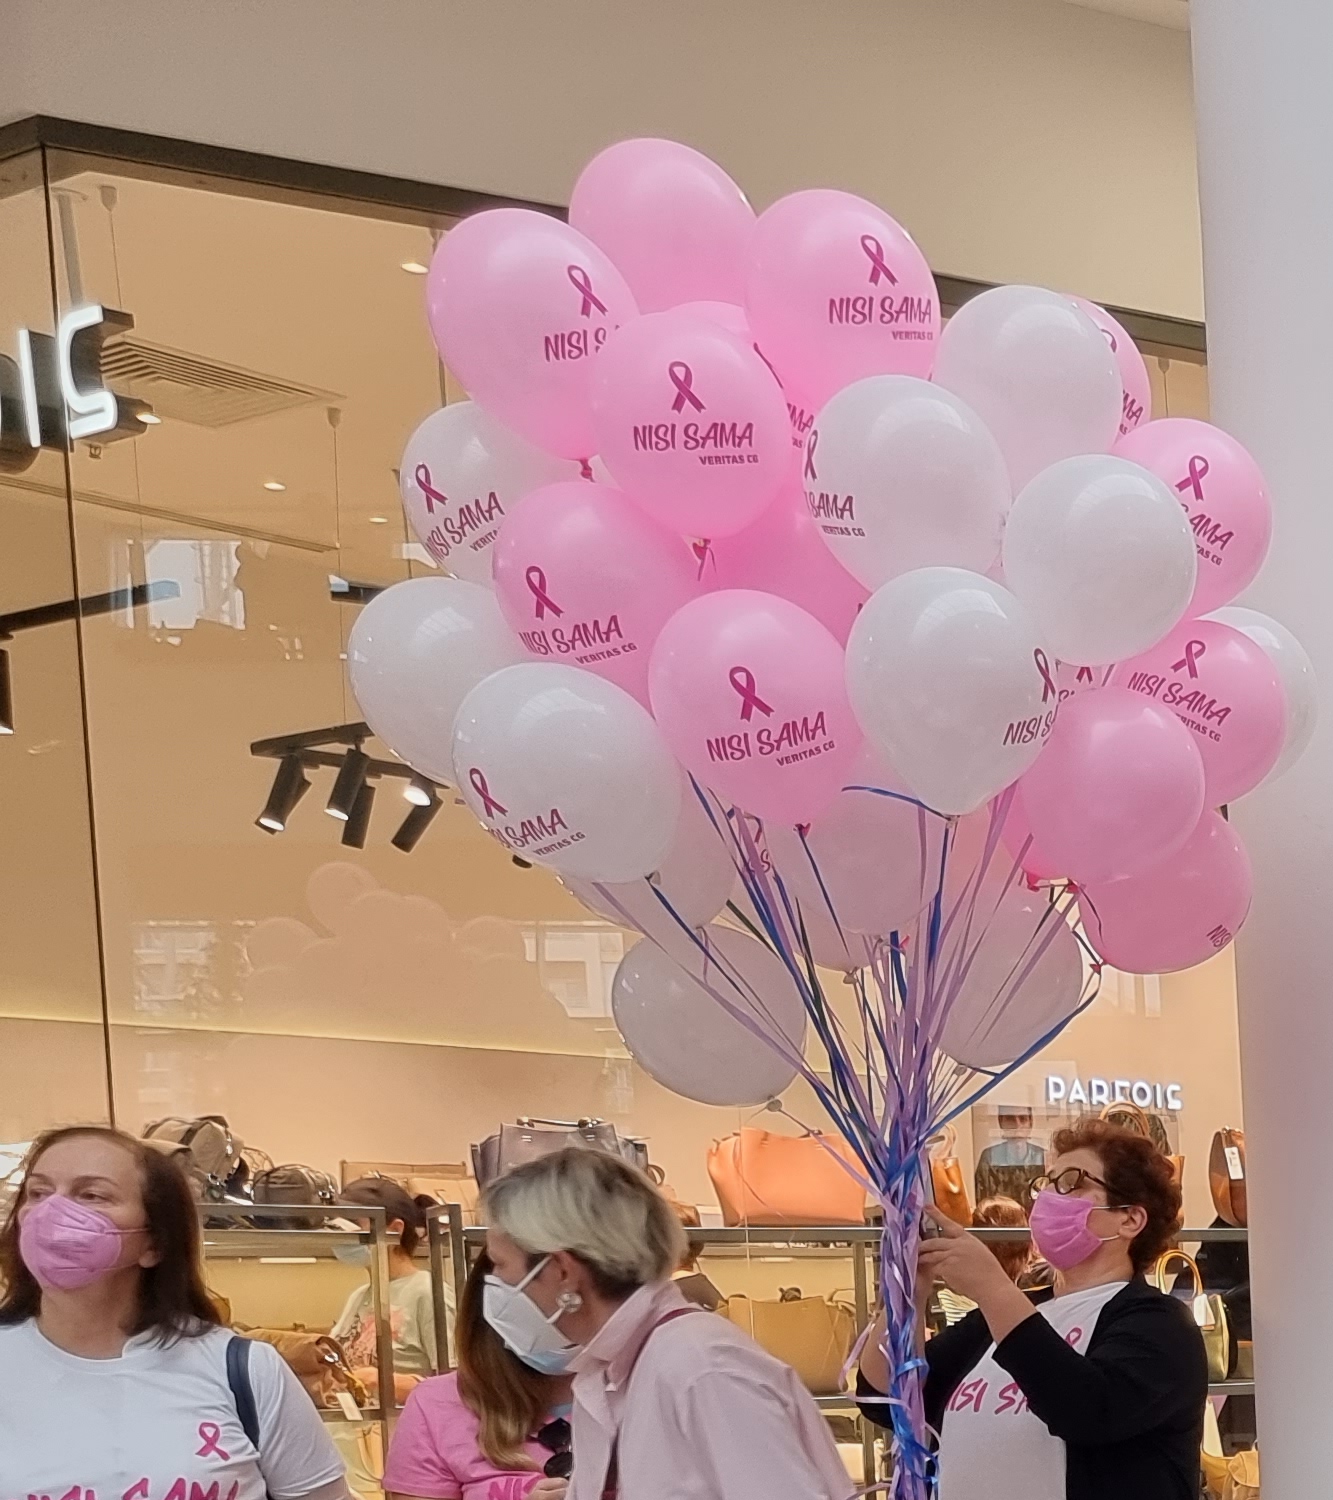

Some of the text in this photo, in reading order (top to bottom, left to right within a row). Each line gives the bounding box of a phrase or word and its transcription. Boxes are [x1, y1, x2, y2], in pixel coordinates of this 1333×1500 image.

[828, 296, 932, 325] NISI SAMA
[544, 329, 588, 362] NISI
[892, 331, 926, 340] VERITAS
[0, 305, 117, 448] IS
[633, 422, 754, 451] NISI SAMA
[699, 454, 759, 465] VERITAS CG
[443, 491, 505, 544] SAMA
[809, 491, 855, 521] SAMA
[469, 526, 501, 552] VERIT
[821, 525, 866, 537] VERITAS CG
[1211, 553, 1223, 566] CG
[518, 615, 623, 655] NISI SAMA
[575, 642, 638, 665] VERITAS CG
[1127, 671, 1232, 726] NISI SAMA
[706, 711, 827, 763] NISI SAMA
[1003, 715, 1043, 746] NISI
[1175, 713, 1222, 743] RITAS CG
[775, 740, 836, 767] VERITAS CG
[504, 808, 569, 849] SAMA
[532, 831, 586, 857] VERITAS CG
[1045, 1075, 1184, 1111] PARFOIS
[945, 1378, 989, 1413] ISI
